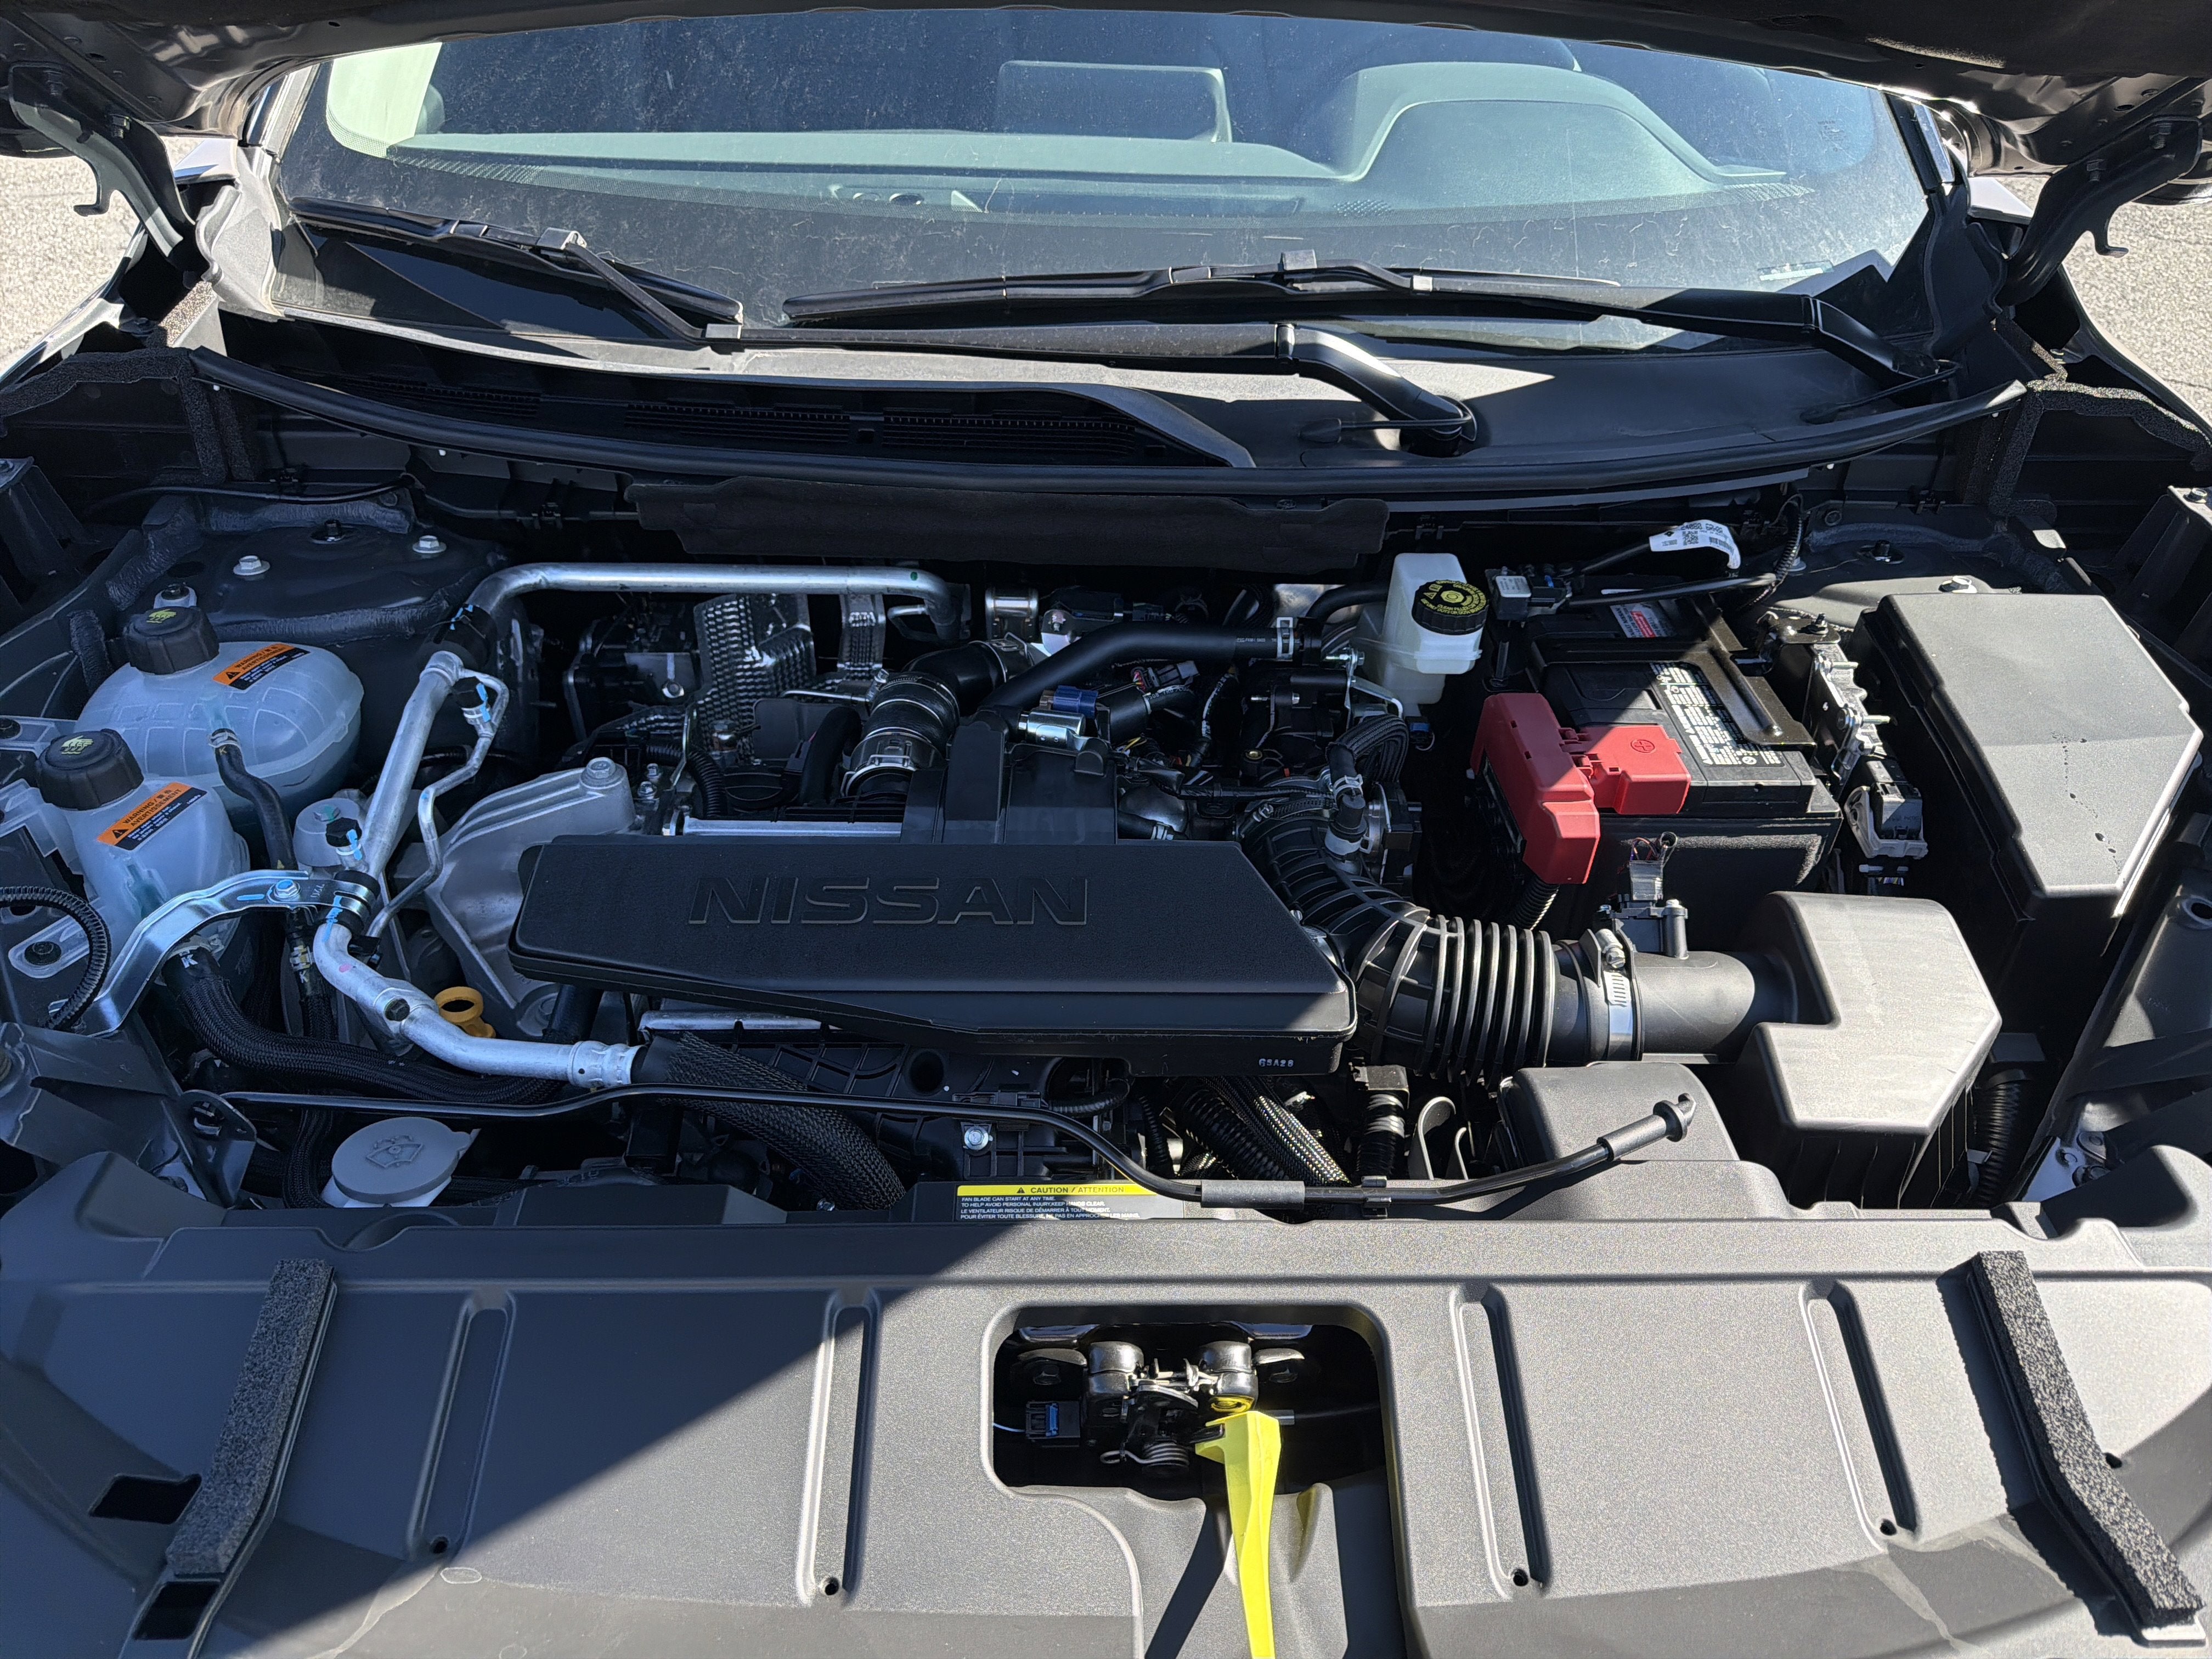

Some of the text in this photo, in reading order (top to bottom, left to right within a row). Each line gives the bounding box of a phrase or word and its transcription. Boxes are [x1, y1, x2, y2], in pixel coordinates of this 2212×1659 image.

[123, 802, 155, 824] WARNING
[132, 789, 182, 827] AVERTISSEMENT
[687, 877, 1087, 925] NISSAN
